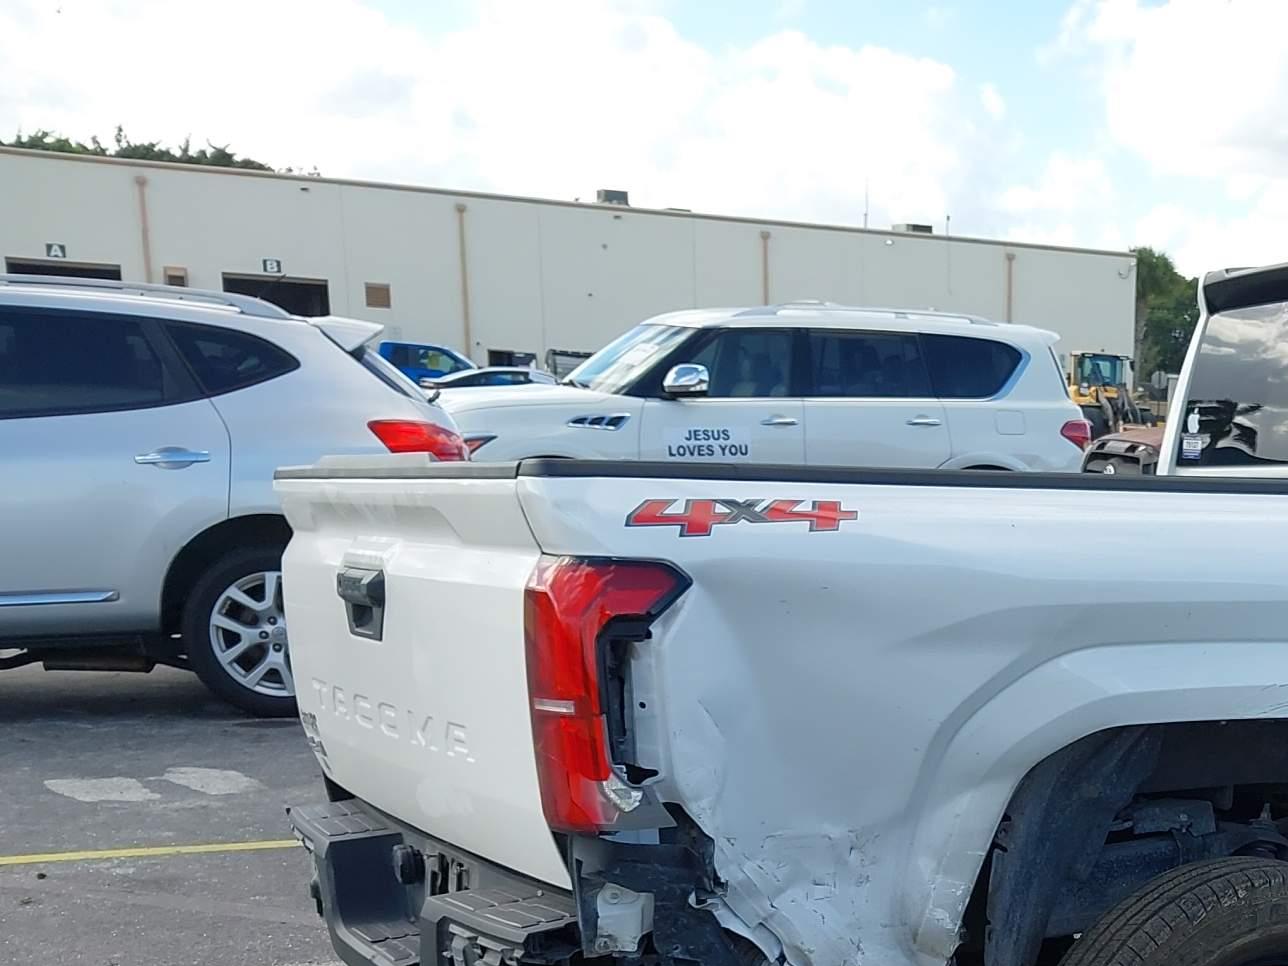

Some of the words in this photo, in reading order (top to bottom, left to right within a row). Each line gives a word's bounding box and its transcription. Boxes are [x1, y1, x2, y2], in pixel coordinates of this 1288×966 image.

[49, 244, 63, 258] A
[265, 260, 278, 272] B
[684, 429, 731, 441] JESUS
[667, 444, 715, 457] LOVES
[719, 444, 749, 457] YOU
[311, 677, 477, 763] TACOMA
